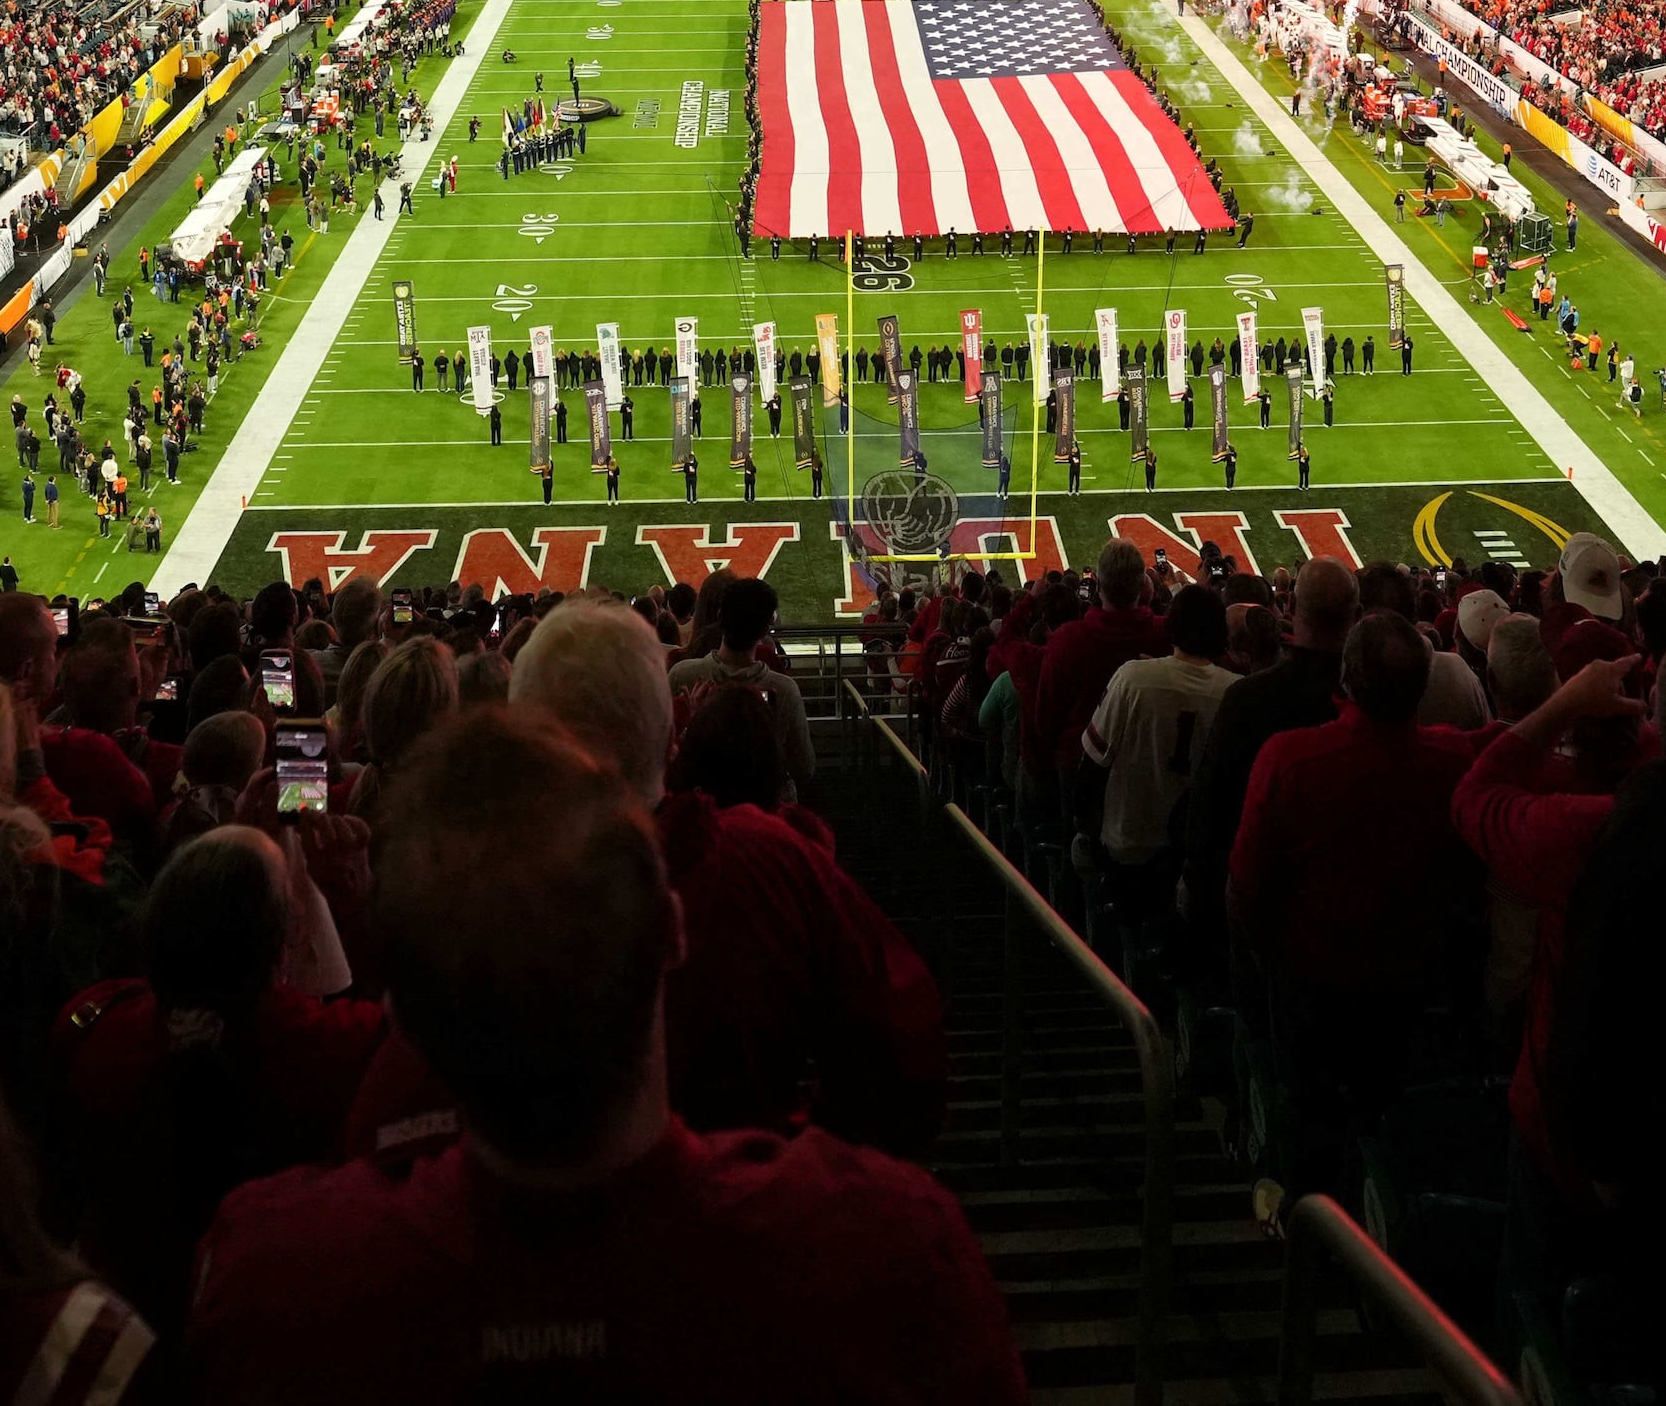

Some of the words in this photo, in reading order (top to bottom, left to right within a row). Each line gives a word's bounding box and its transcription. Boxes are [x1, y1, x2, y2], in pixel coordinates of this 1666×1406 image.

[1436, 40, 1506, 108] CHAMPIONSHIP
[674, 80, 705, 149] CHAMPIONSHIP
[705, 89, 730, 138] NATIONAL
[1597, 169, 1621, 193] AT&T
[517, 212, 559, 237] 30
[491, 283, 538, 312] 20
[1224, 273, 1278, 302] 20
[479, 1316, 608, 1363] INDIANA
